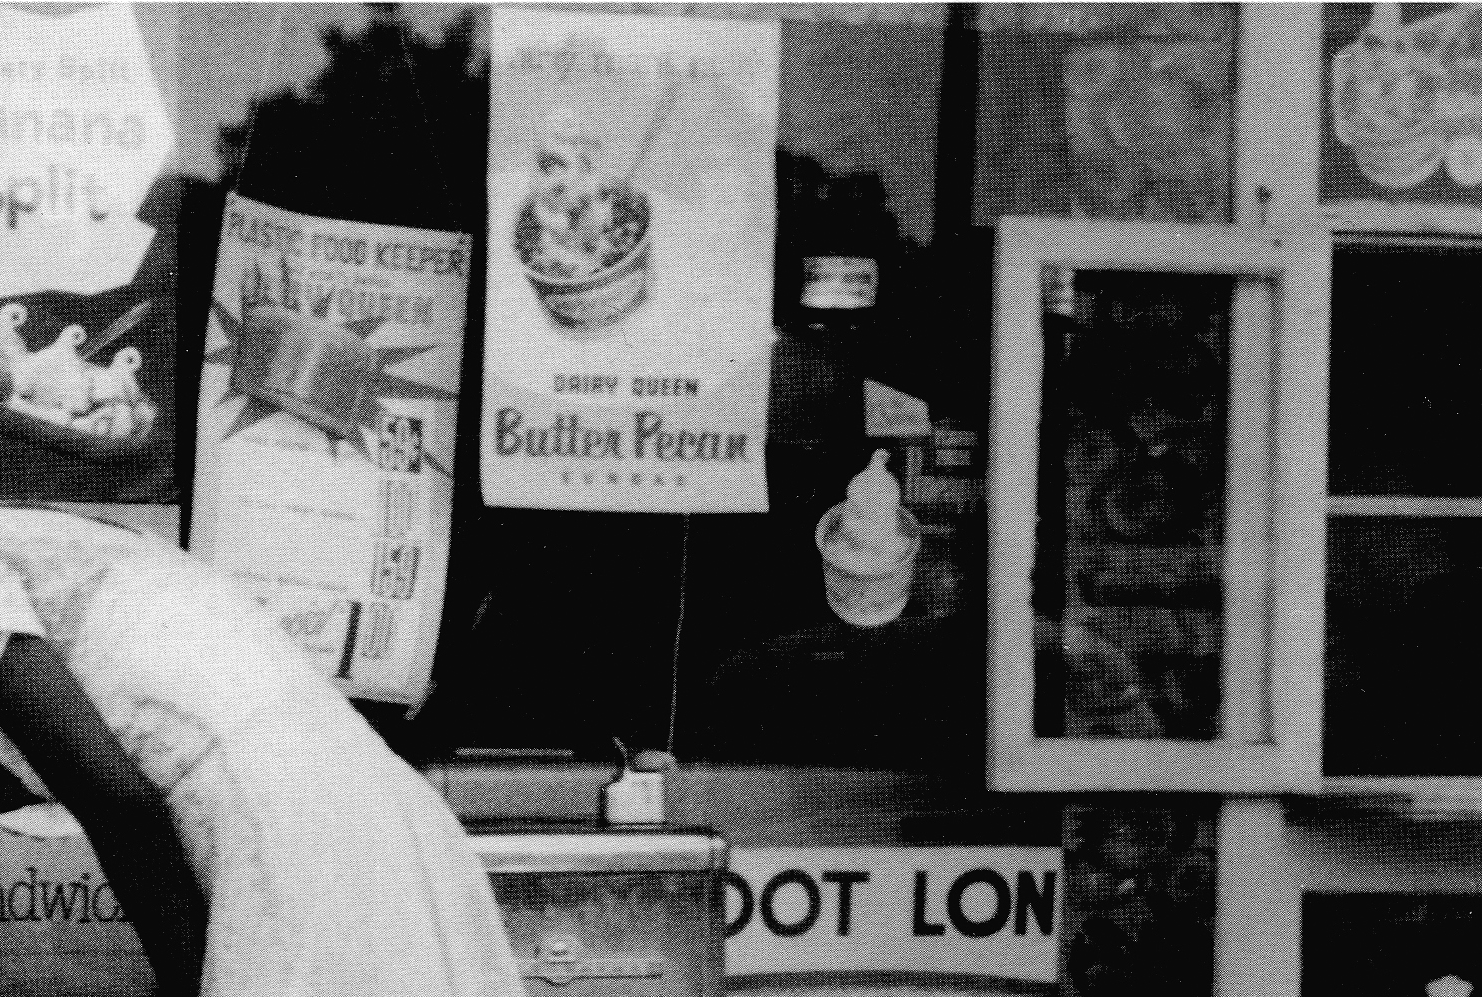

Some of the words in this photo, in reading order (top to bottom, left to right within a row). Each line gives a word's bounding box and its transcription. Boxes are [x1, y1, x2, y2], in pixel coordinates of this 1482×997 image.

[227, 211, 304, 257] PLASTIC
[310, 232, 369, 266] FOOD
[375, 241, 465, 278] KEEPER
[553, 374, 618, 395] DAIRY
[632, 376, 699, 397] QUEEN
[494, 406, 624, 458] Butter
[633, 410, 750, 462] Pecan
[913, 868, 1056, 938] LON
